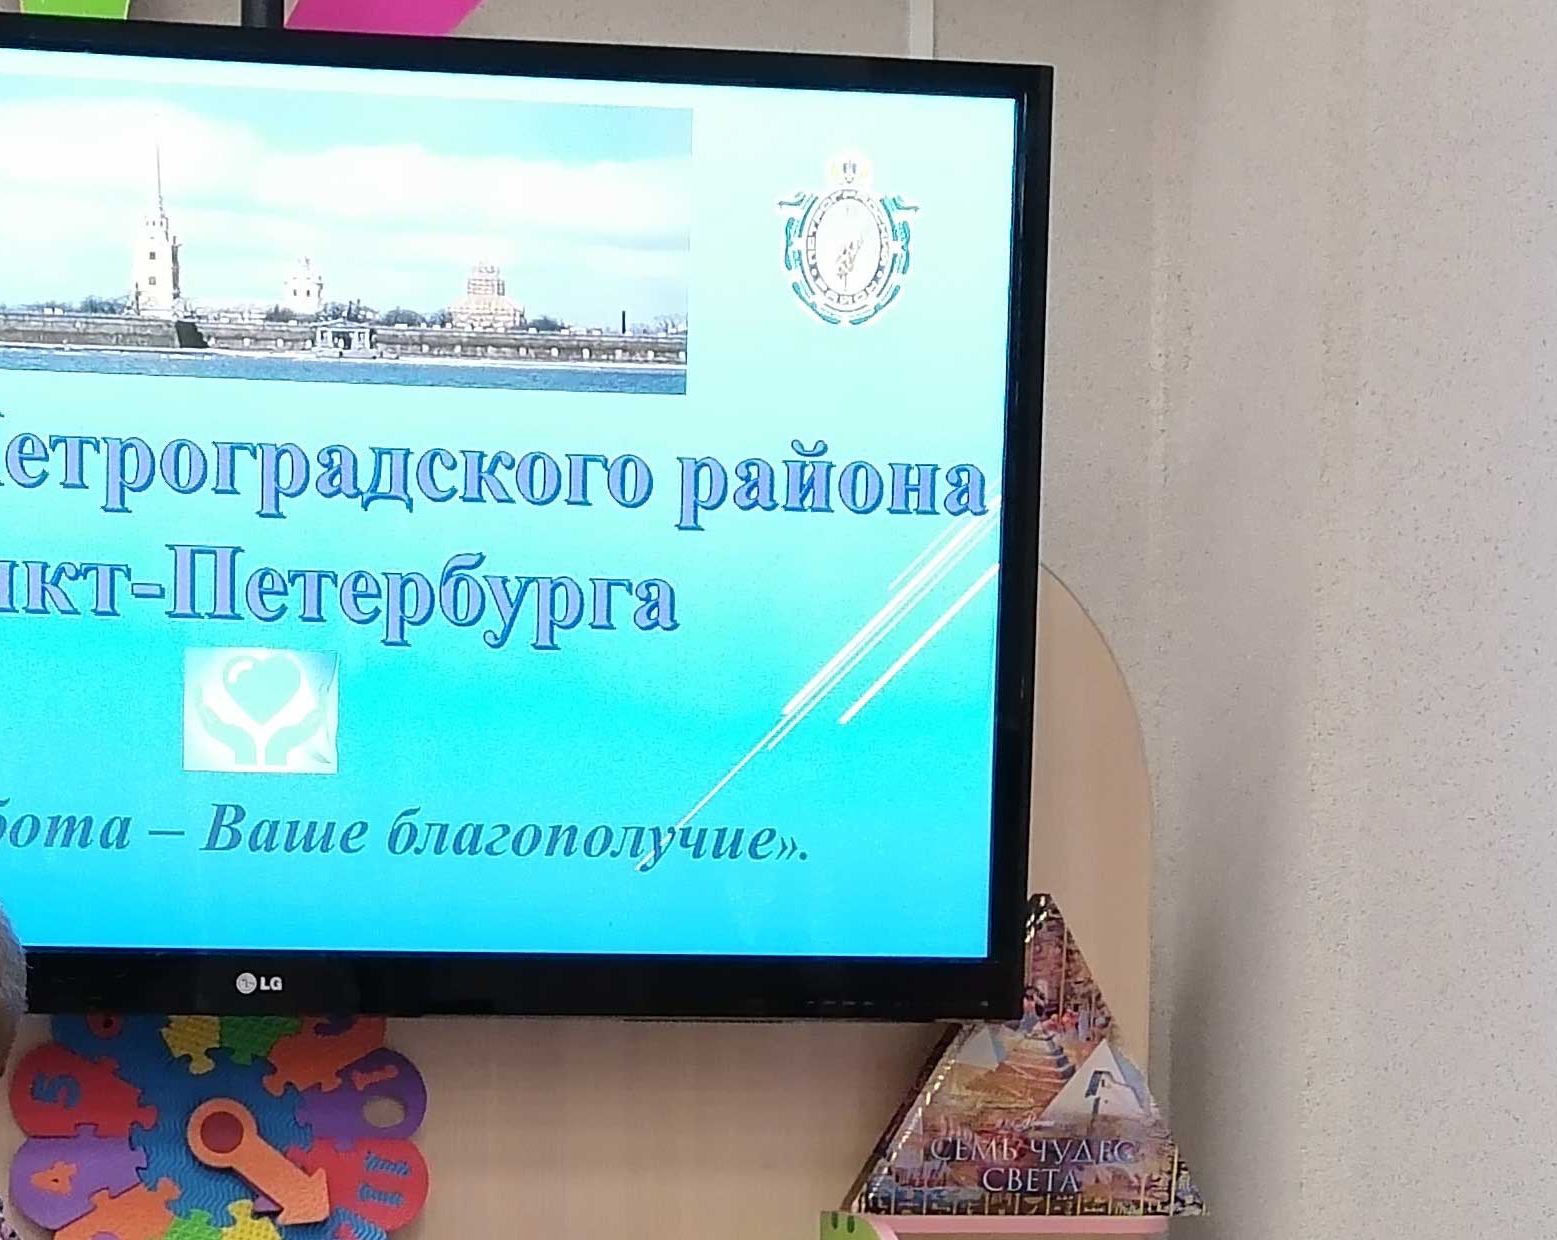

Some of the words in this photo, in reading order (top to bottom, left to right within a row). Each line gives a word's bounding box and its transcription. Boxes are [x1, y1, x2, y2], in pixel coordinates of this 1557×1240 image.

[674, 440, 989, 531] района
[199, 803, 369, 855] Ваше
[387, 807, 809, 873] благополучие».
[259, 975, 283, 992] LG
[929, 1138, 1019, 1163] СЕМЬ
[1029, 1138, 1137, 1165] ЧУДЕС
[981, 1167, 1083, 1194] СВЕТА
